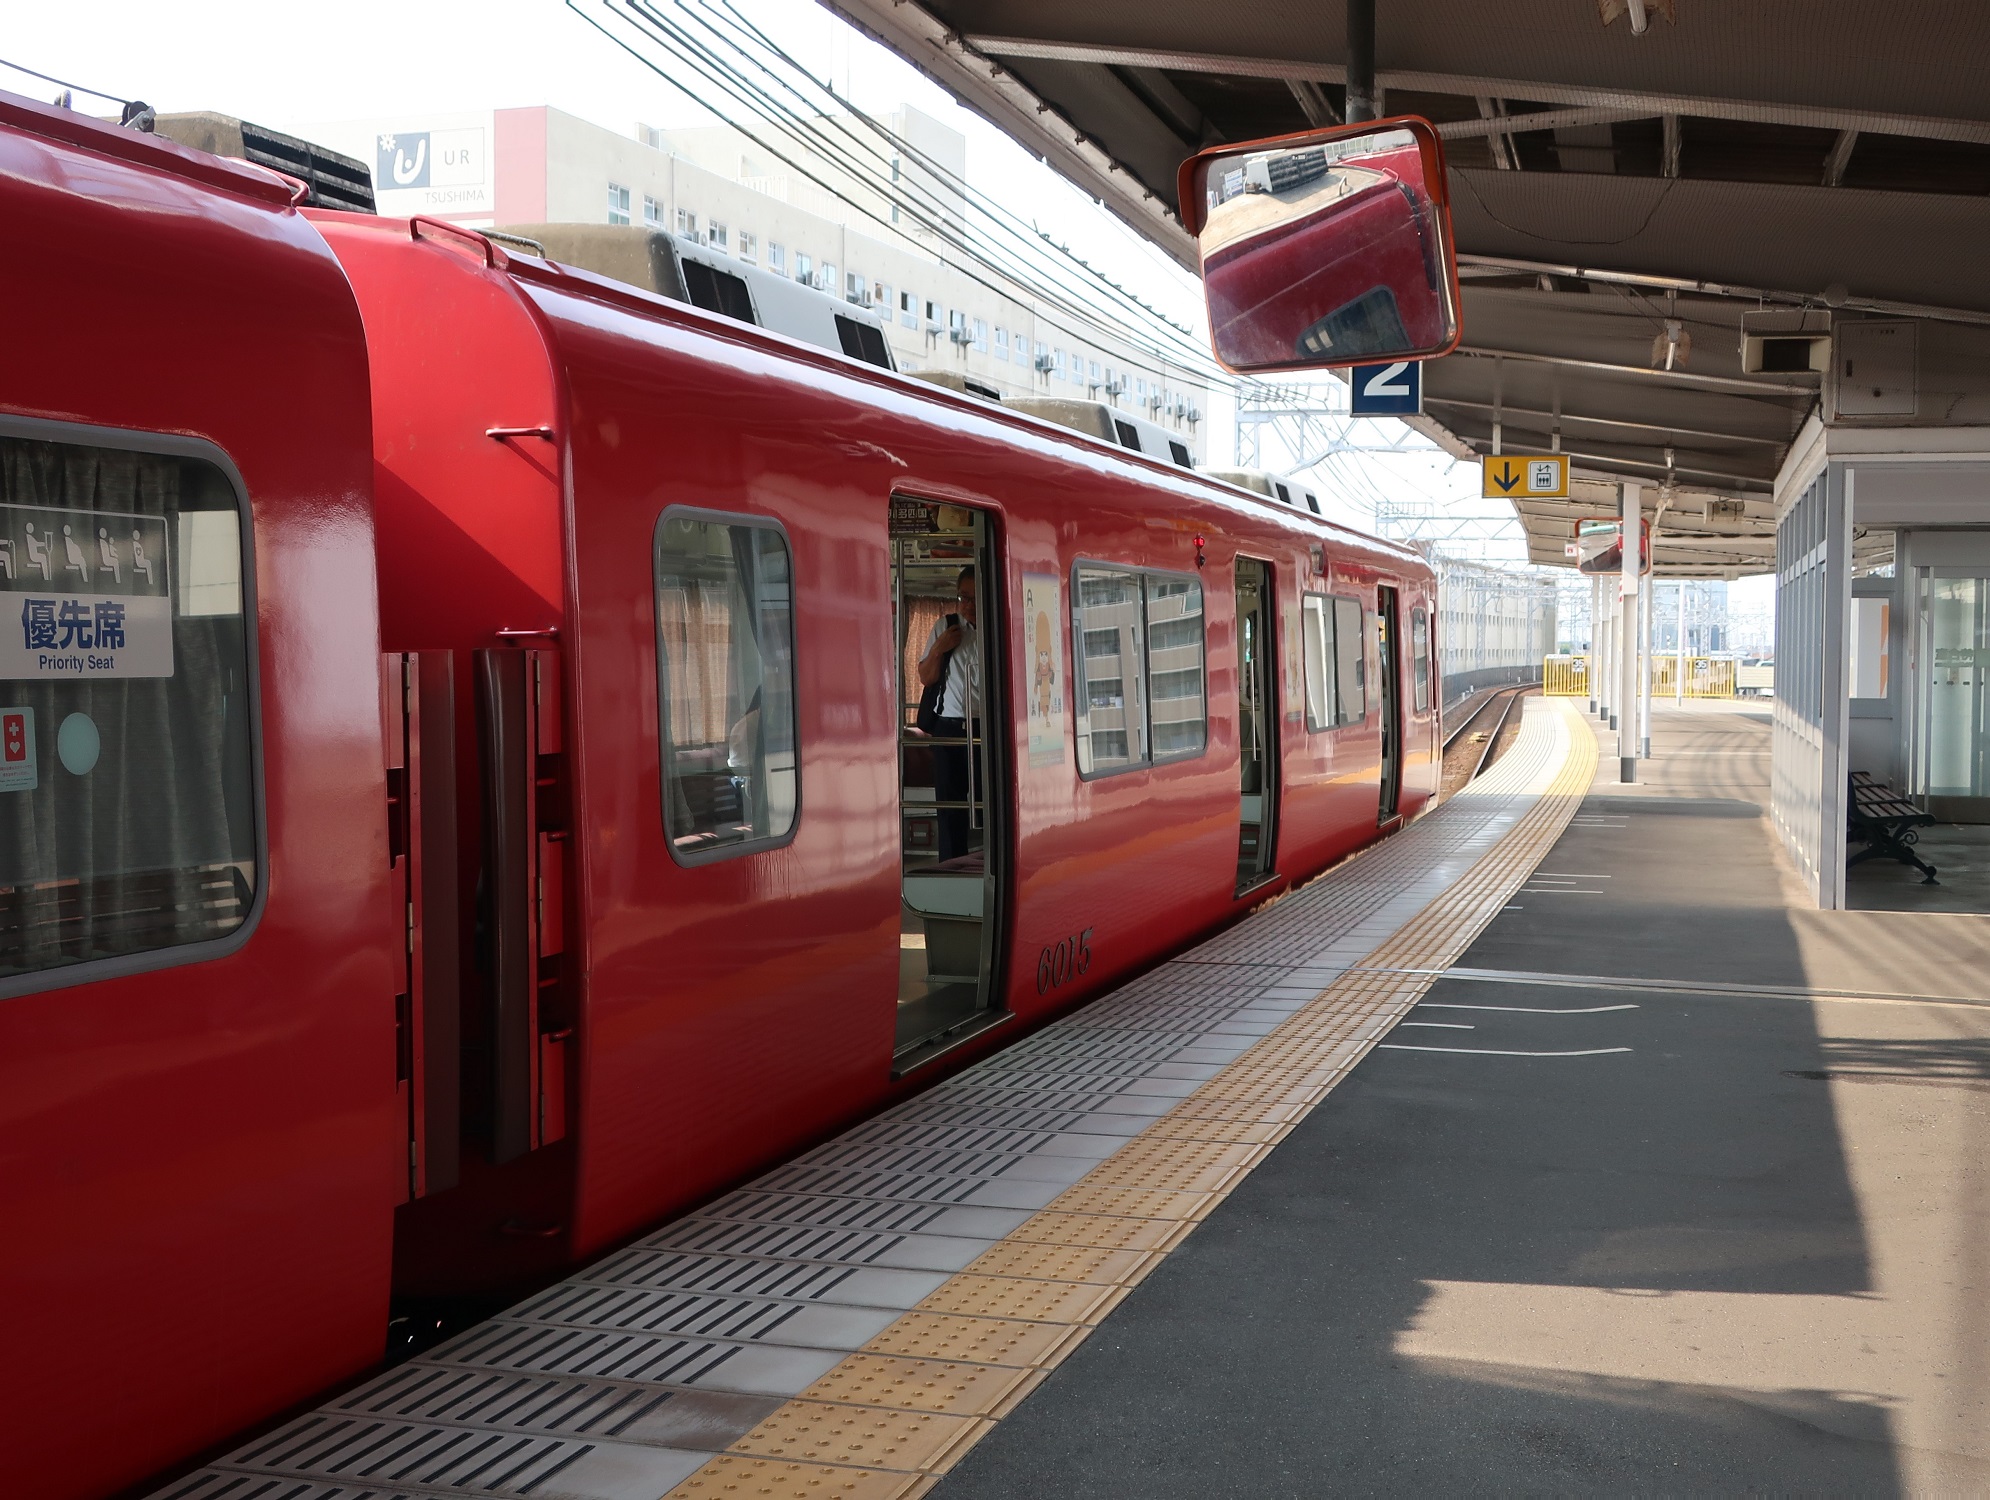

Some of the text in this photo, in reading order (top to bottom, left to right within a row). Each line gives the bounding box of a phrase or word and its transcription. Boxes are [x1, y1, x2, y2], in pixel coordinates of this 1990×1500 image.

[445, 150, 469, 165] UR
[425, 190, 484, 203] TSUSHIMA
[1363, 361, 1410, 397] 2
[22, 599, 125, 649] 優先席
[40, 655, 114, 672] Priority Seat
[1038, 927, 1093, 995] 6015
